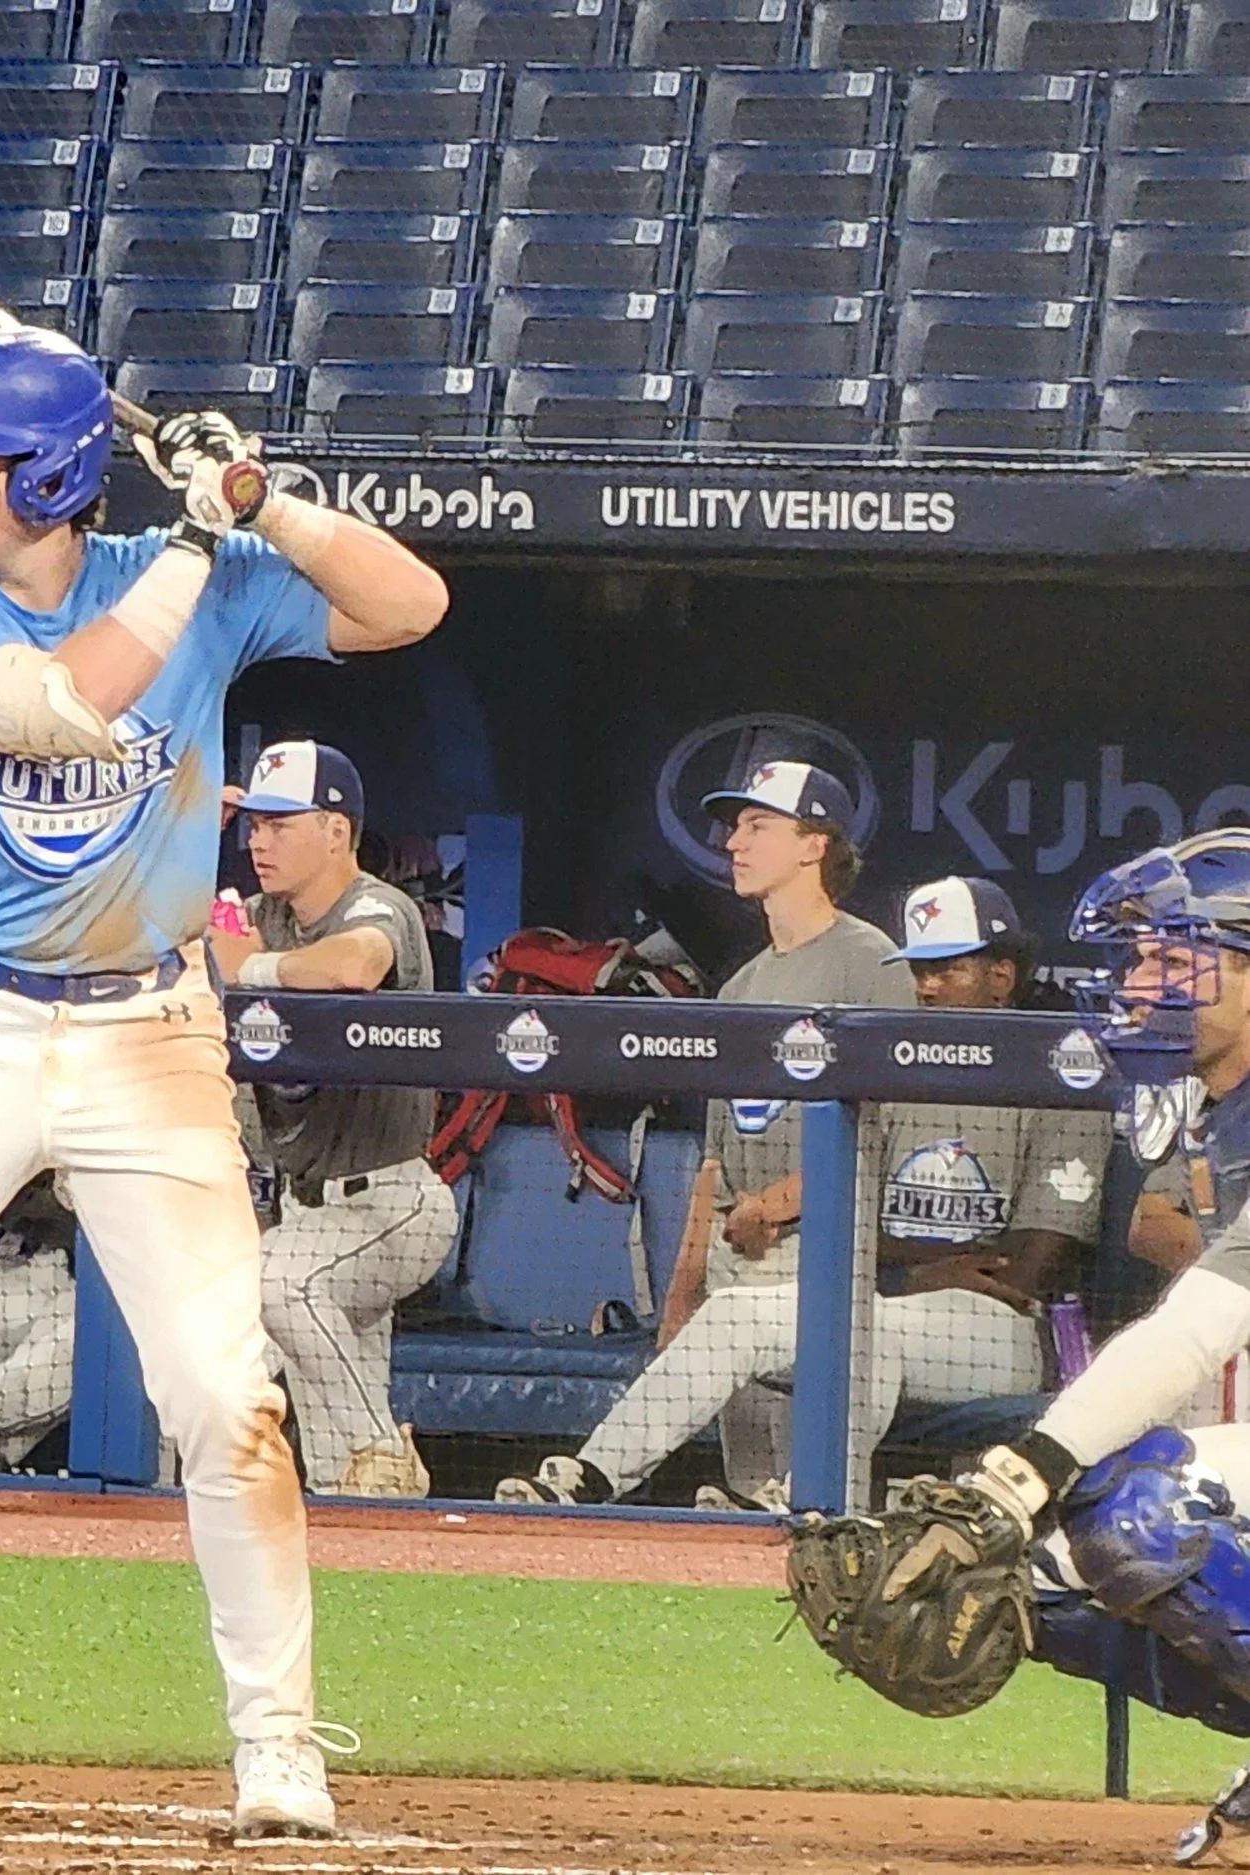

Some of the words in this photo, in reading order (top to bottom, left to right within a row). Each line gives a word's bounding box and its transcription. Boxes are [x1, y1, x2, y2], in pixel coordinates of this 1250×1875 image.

[337, 472, 535, 531] Kubota
[601, 486, 751, 530] UTILITY
[759, 489, 956, 533] VEHICLES
[911, 740, 1250, 874] Kub
[368, 1026, 442, 1049] ROGERS
[642, 1036, 718, 1058] ROGERS
[917, 1043, 993, 1066] ROGERS
[883, 1188, 997, 1223] FUTURES
